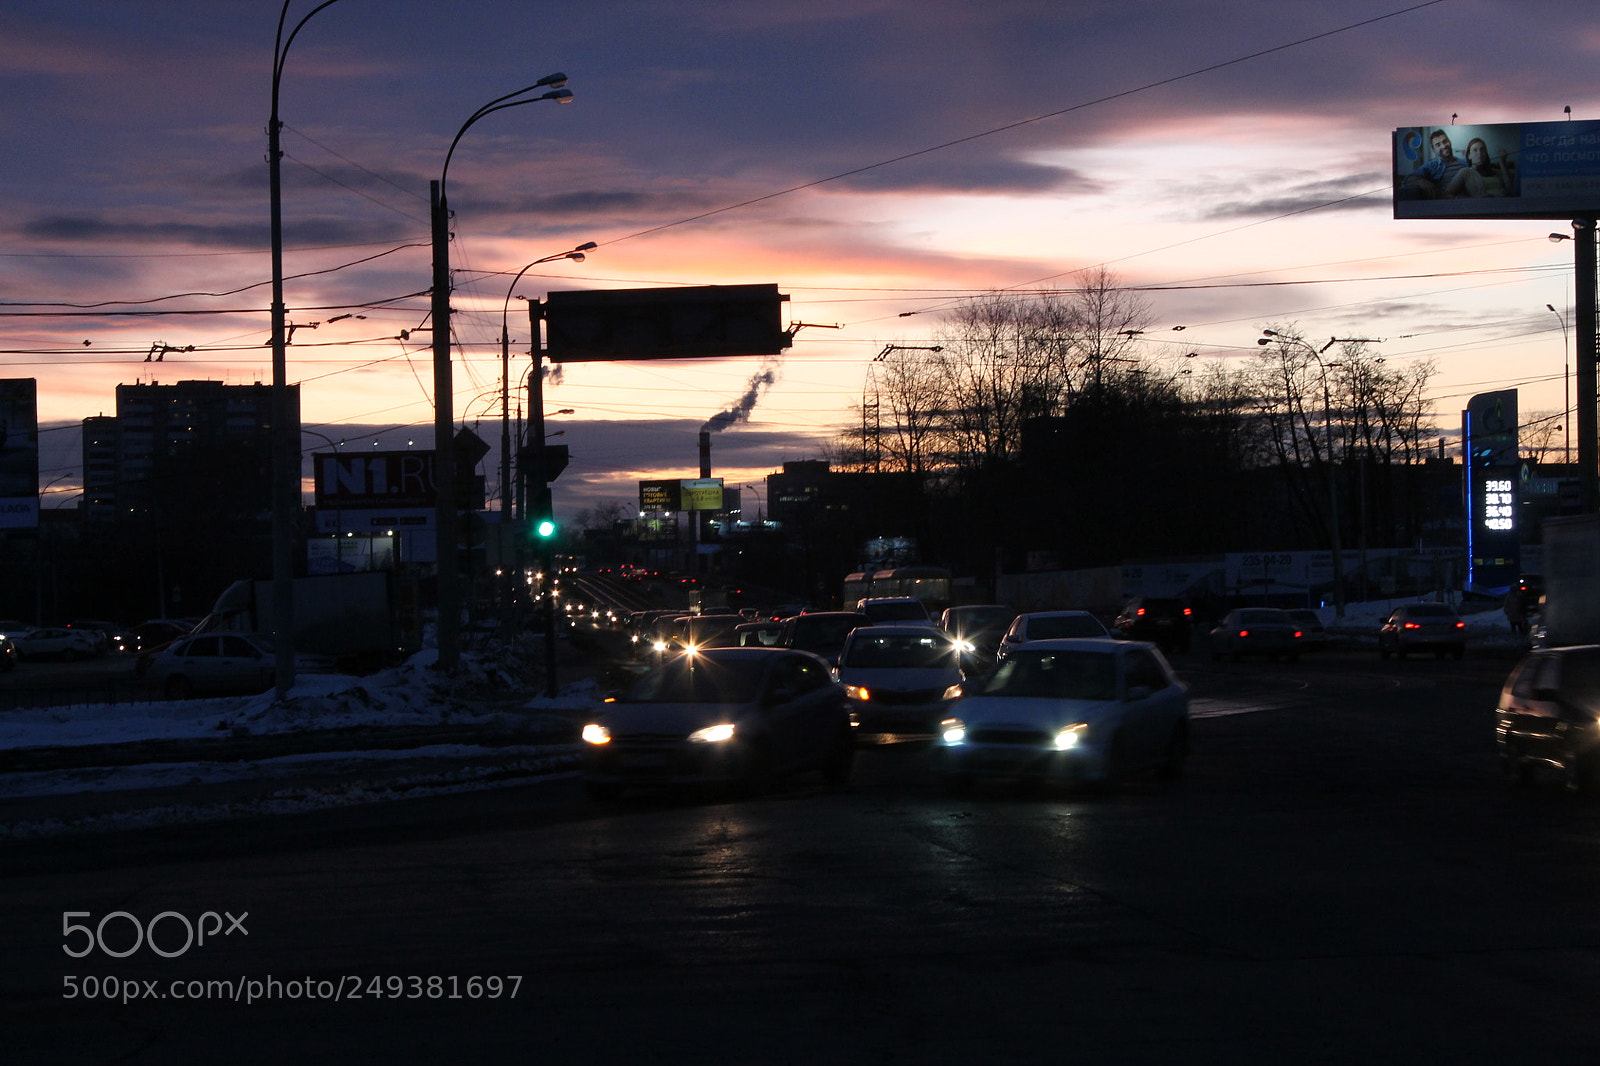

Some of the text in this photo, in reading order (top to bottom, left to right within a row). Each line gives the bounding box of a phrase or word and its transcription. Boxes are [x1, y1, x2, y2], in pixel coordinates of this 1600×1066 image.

[1526, 134, 1575, 148] Всегда
[1526, 152, 1548, 163] что
[1485, 480, 1511, 492] 39.60
[1, 504, 31, 514] LADA
[1242, 554, 1292, 566] 235-04-20
